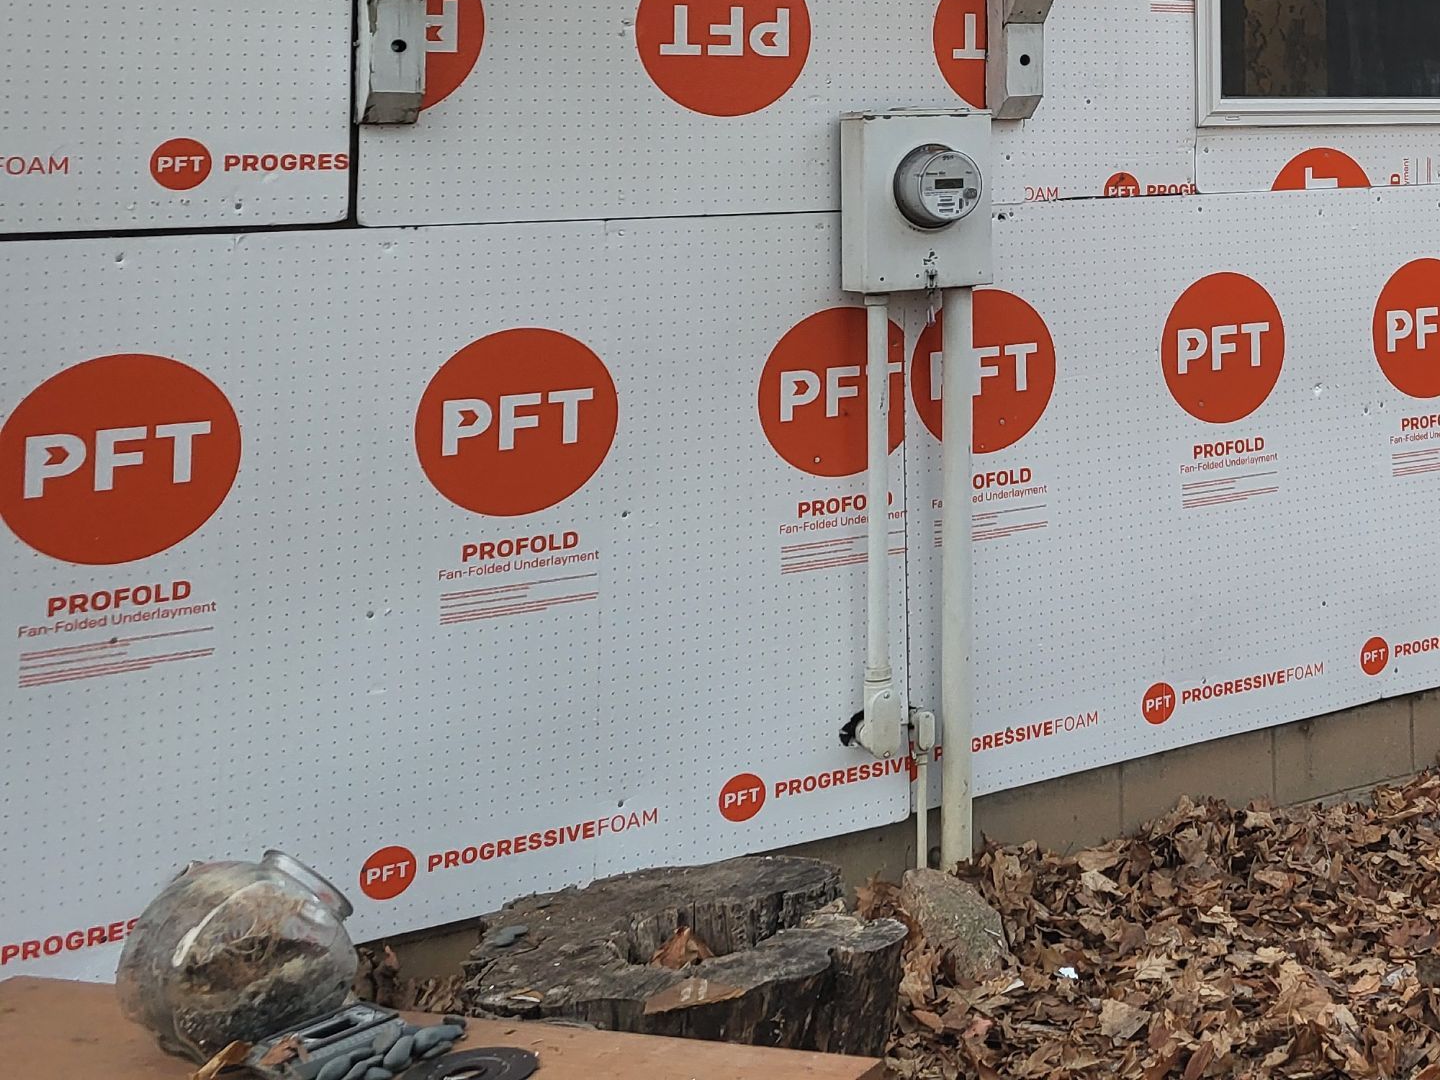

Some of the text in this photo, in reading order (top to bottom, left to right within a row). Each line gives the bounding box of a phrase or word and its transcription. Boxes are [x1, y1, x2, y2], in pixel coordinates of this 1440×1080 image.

[660, 4, 790, 57] PFT
[157, 155, 203, 173] PFT
[1177, 322, 1270, 374] PFT
[442, 388, 594, 457] PFT
[24, 421, 211, 499] PFT
[1179, 452, 1278, 474] Fan-Folded Underlayment
[1192, 436, 1265, 460] PROFOLD
[972, 467, 1032, 490] OFOLD
[985, 484, 1047, 502] Underlayment
[797, 492, 893, 520] PROFO
[779, 519, 838, 535] Fan-Folded
[461, 530, 580, 564] PROFOLD
[437, 549, 600, 581] Fan-Folded Underlayment
[47, 579, 192, 618] PROFOLD
[17, 601, 217, 638] Fan-Folded Underlayment
[1363, 648, 1386, 665] PFT
[1145, 662, 1325, 712] PFT PROGRESSIVEFOAM
[934, 710, 1100, 762] PGRESSIVEFOAM
[724, 787, 760, 808] PFT
[366, 808, 659, 885] PFT PROGRESSIVEFOAM
